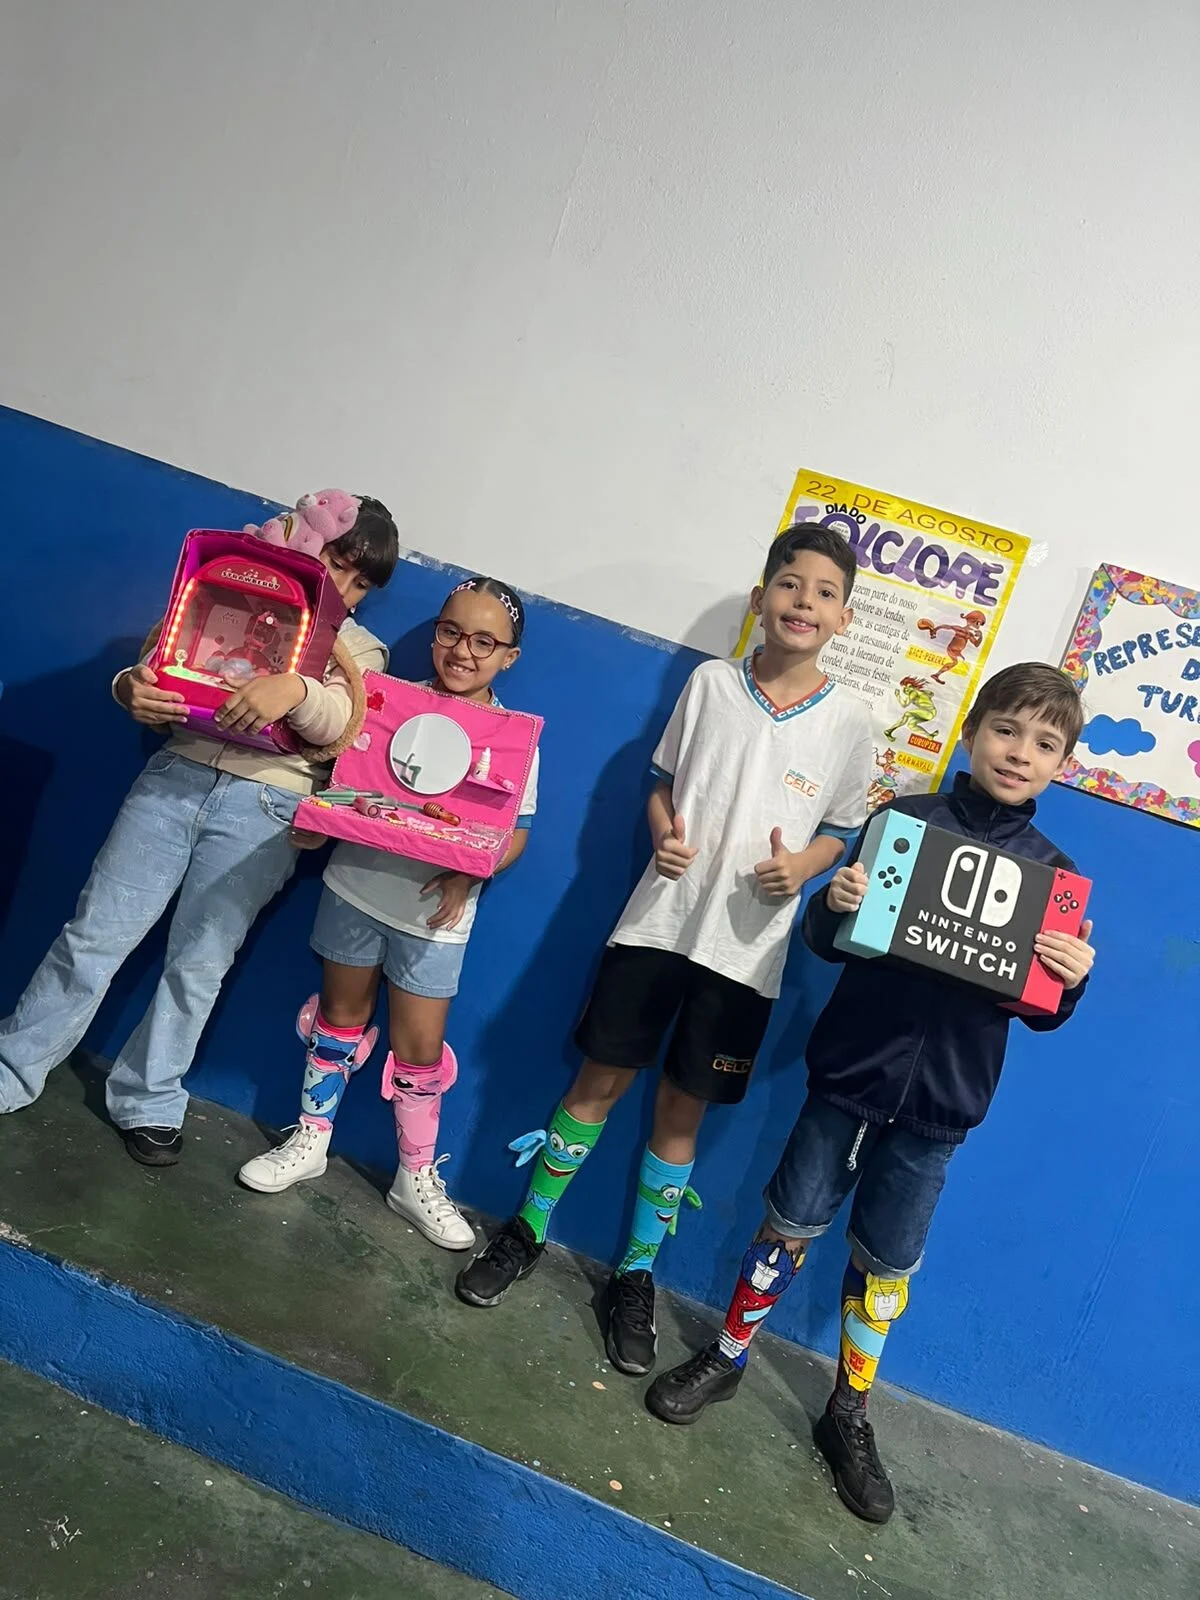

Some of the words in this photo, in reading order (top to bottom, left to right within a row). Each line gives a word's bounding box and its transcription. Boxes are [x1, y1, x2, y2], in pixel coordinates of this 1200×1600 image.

[806, 480, 836, 500] 22
[852, 493, 890, 516] DE
[897, 508, 1014, 553] AGOSTO
[825, 503, 847, 515] DIA
[848, 508, 867, 524] DO
[853, 584, 871, 597] azem
[871, 588, 890, 602] parte
[889, 593, 898, 605] do
[898, 598, 918, 611] nosso
[874, 606, 883, 617] as
[884, 607, 906, 624] lendas,
[865, 619, 874, 629] as
[873, 621, 900, 639] cantigas
[901, 629, 910, 641] de
[853, 632, 859, 641] o
[858, 633, 892, 651] artesanato
[892, 642, 902, 655] de
[843, 658, 871, 678] algumas
[849, 647, 856, 656] a
[855, 646, 884, 665] literatura
[885, 655, 895, 668] de
[861, 680, 885, 698] danças
[777, 699, 812, 719] CELC
[1137, 684, 1200, 724] TUR
[897, 754, 931, 771] CARNAVAL
[783, 773, 818, 798] CELC
[917, 909, 1017, 953] NINTENDO
[904, 925, 1018, 981] SWITCH
[712, 1058, 752, 1073] CELC
